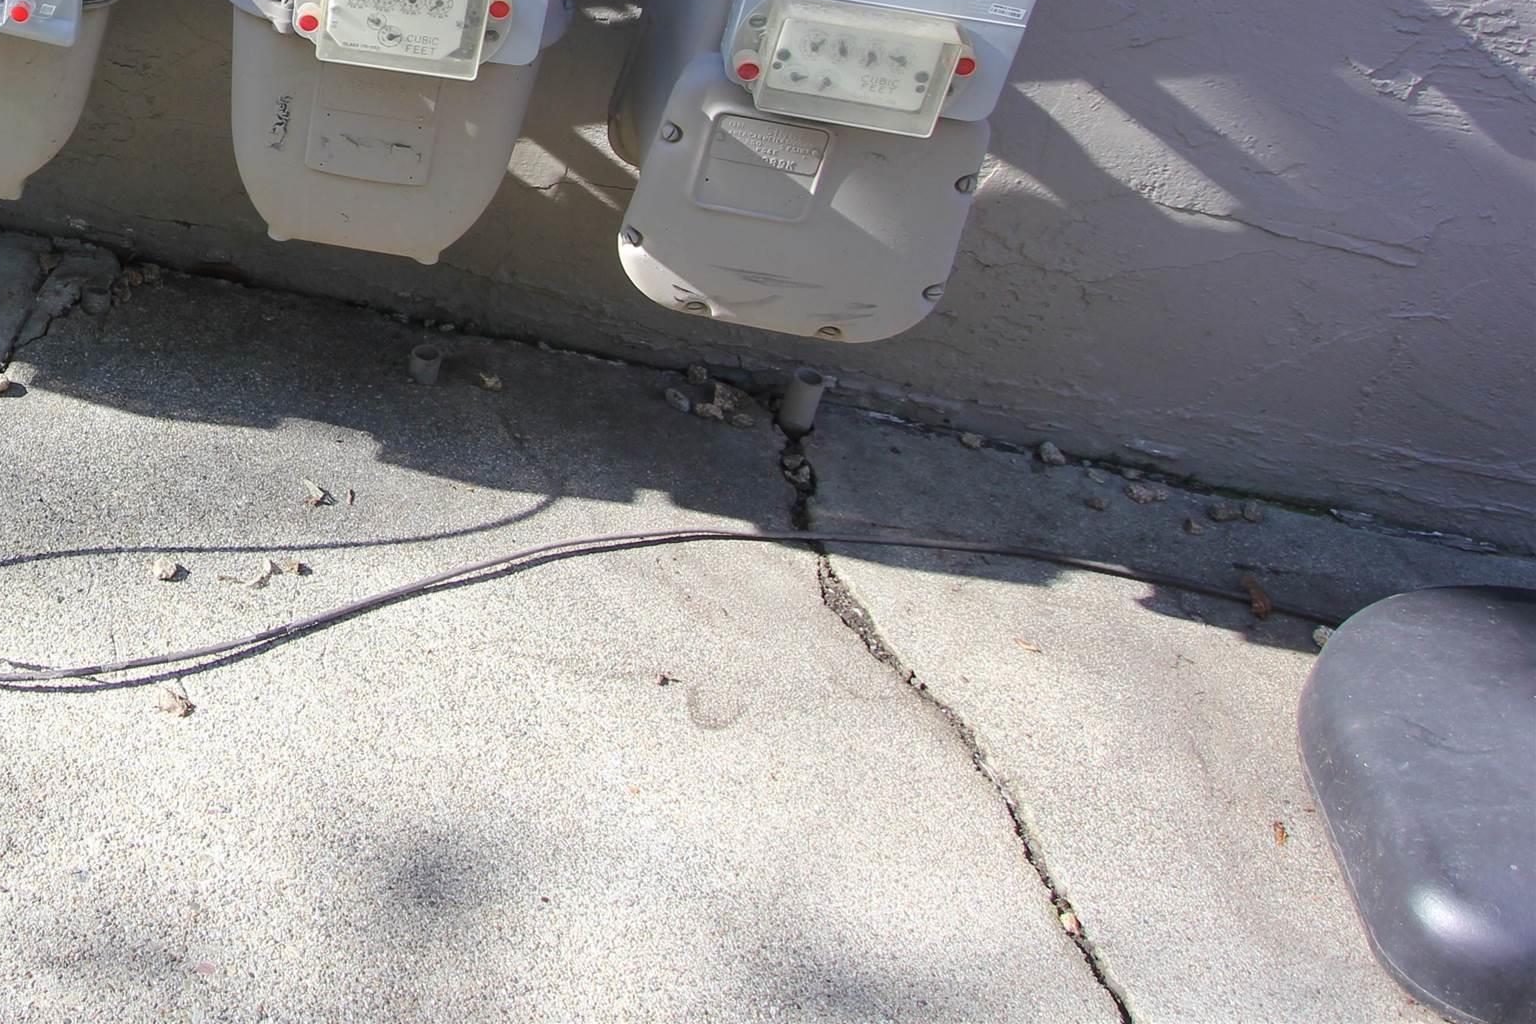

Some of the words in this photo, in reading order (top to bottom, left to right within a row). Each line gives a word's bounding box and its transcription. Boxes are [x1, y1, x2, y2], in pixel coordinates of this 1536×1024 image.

[406, 34, 440, 47] CUBIC
[405, 45, 437, 56] FEET
[861, 75, 900, 89] CUBIC
